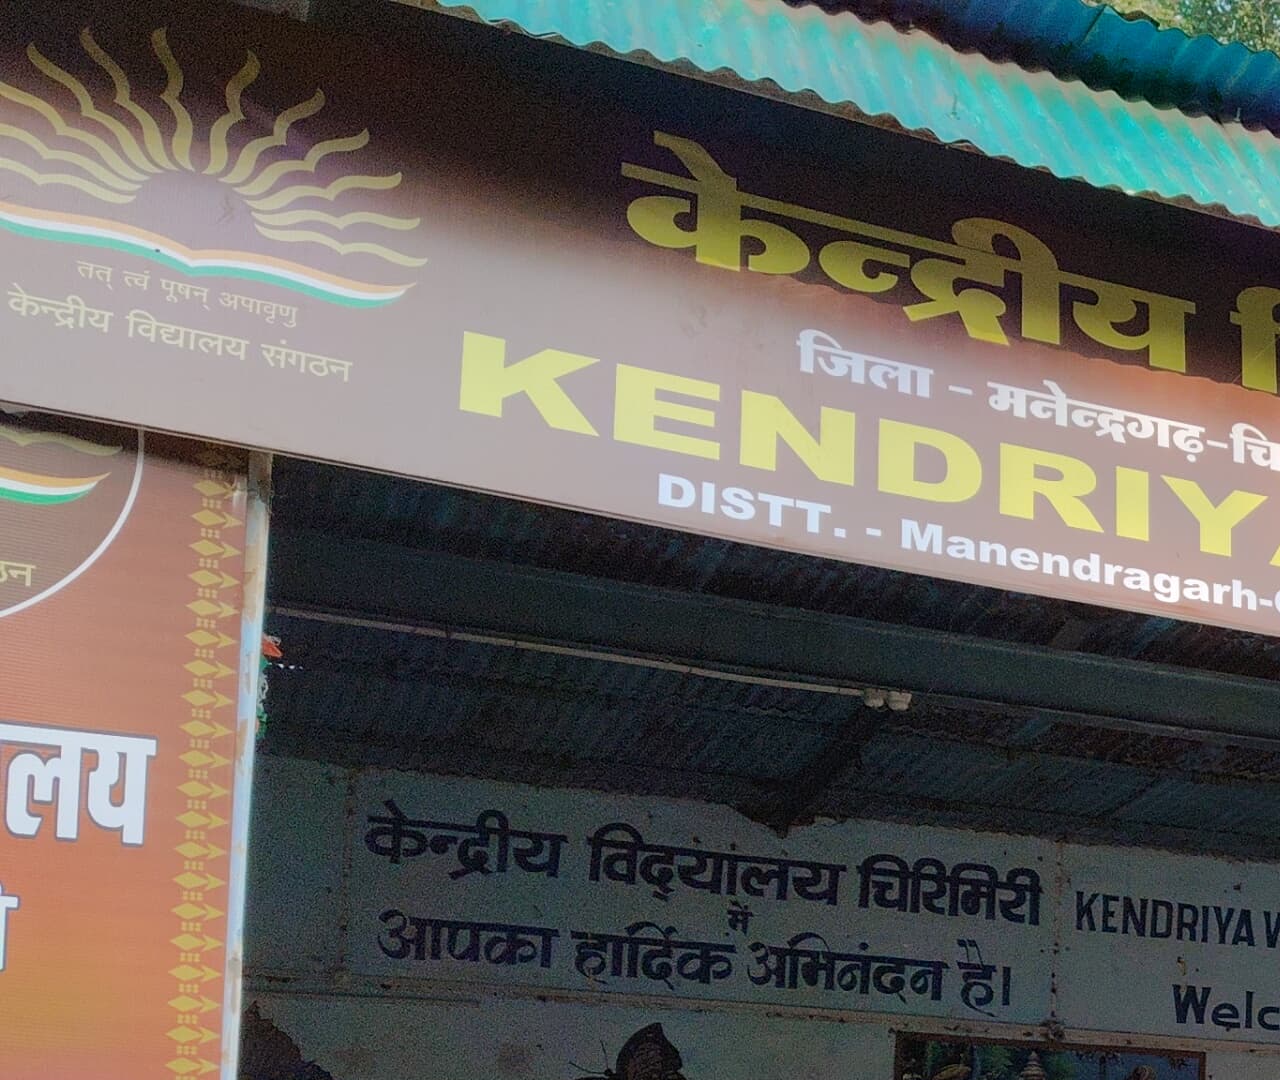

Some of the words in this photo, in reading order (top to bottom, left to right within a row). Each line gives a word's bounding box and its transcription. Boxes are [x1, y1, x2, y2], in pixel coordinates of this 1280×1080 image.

[620, 130, 1196, 374] केन्द्रीय
[77, 261, 112, 289] तत्
[123, 270, 151, 290] त्वं
[159, 279, 210, 311] पूषन्
[219, 291, 299, 328] अपावृणु
[7, 282, 113, 333] केन्द्रीय
[126, 309, 250, 361] विद्यालय
[261, 339, 353, 382] संगठन
[797, 328, 934, 398] जिला
[657, 474, 847, 538] DISTT.
[365, 801, 569, 880] केन्द्रीय
[377, 907, 559, 968] आपका
[571, 921, 736, 989] हार्दिक
[747, 932, 949, 1003] अभिनंदन
[1074, 890, 1257, 948] KENDRIYA
